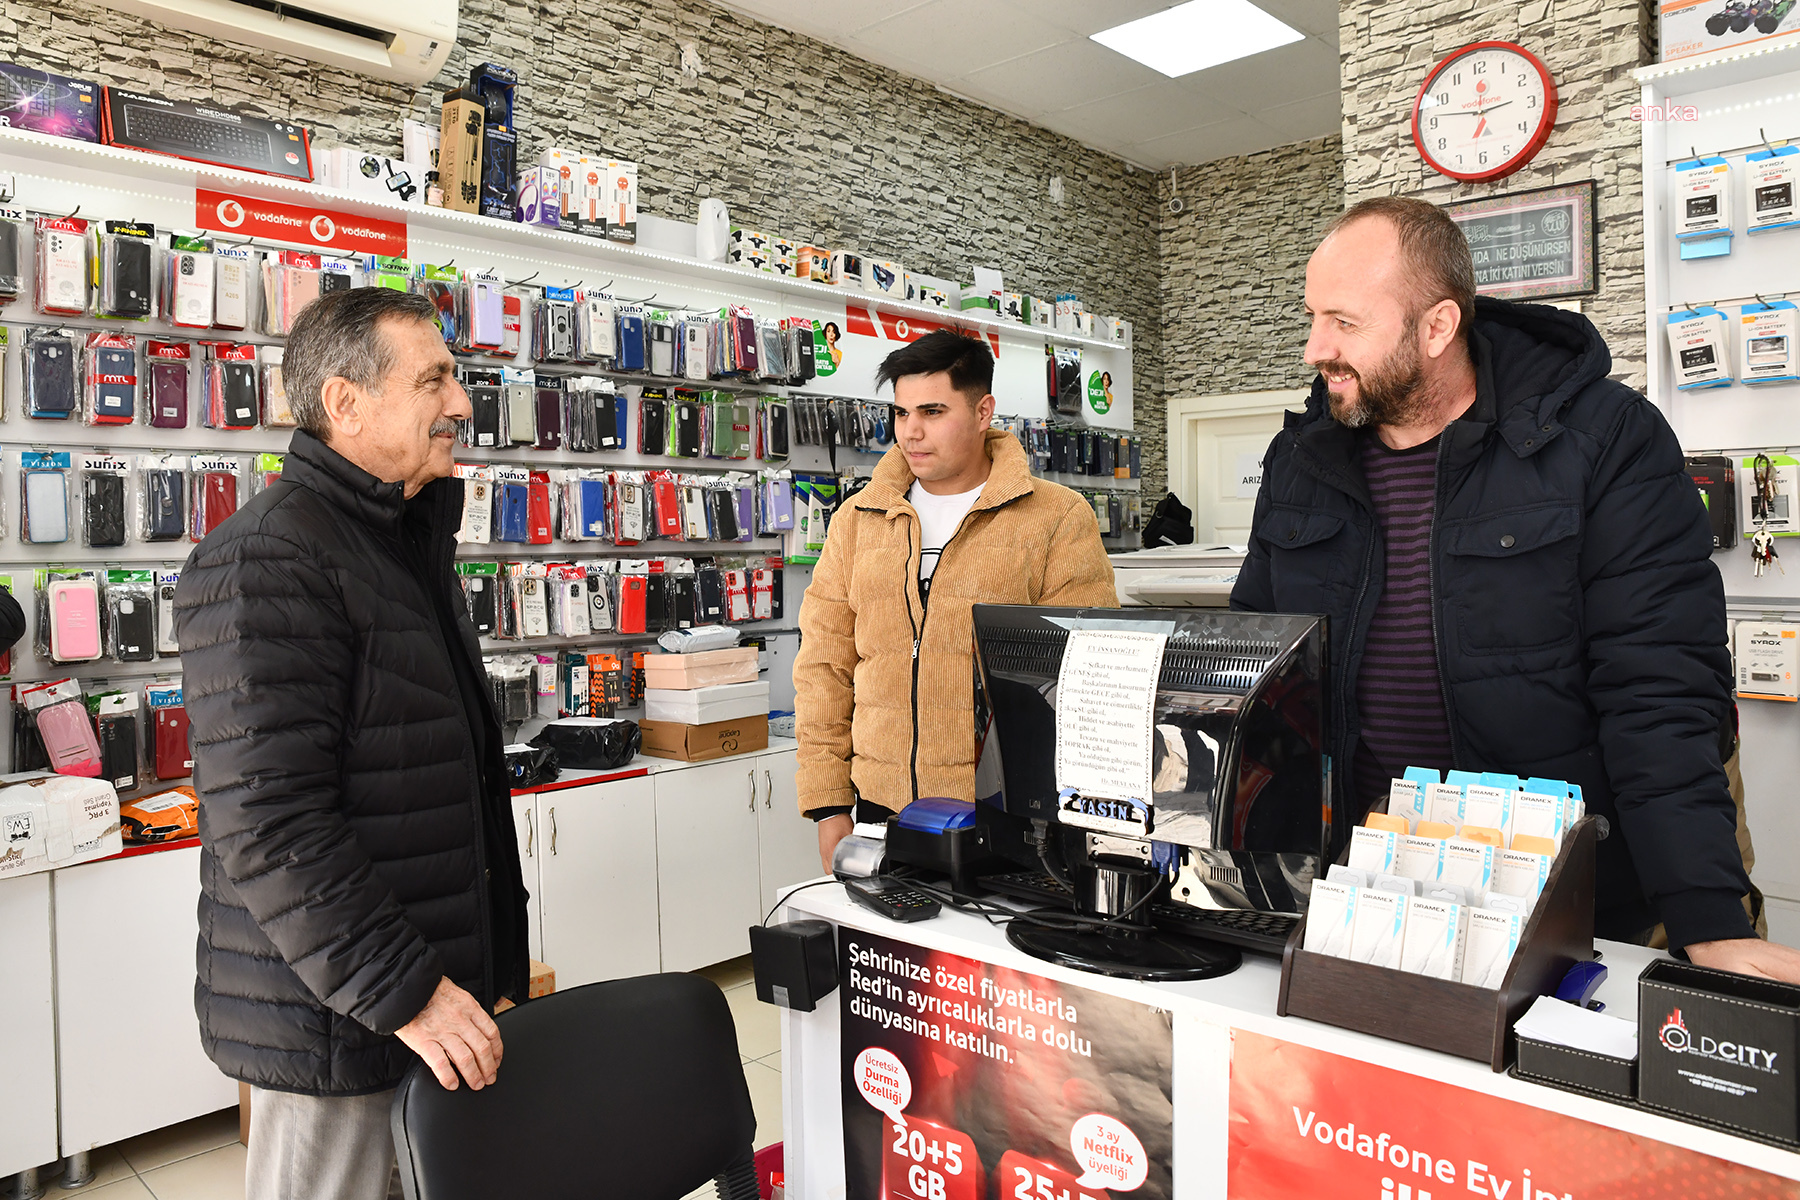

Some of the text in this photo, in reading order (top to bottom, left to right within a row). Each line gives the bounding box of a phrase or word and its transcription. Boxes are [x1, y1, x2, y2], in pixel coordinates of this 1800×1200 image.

[1665, 42, 1704, 56] SPEAKER
[1474, 61, 1486, 75] 12
[1502, 62, 1505, 74] 1
[1453, 72, 1461, 86] 11
[1518, 74, 1526, 87] 2
[1436, 92, 1449, 106] 10
[1462, 94, 1502, 109] vodafone
[1527, 95, 1536, 108] 3
[1430, 117, 1438, 130] 9
[1518, 120, 1528, 134] 4
[1438, 138, 1446, 150] 8
[1502, 144, 1510, 156] 5
[1456, 154, 1462, 164] 7
[1478, 151, 1488, 164] 6
[1759, 160, 1784, 168] SYROX
[254, 212, 302, 227] vodafone
[342, 226, 386, 240] vodafone
[1496, 248, 1508, 261] NE
[1510, 240, 1571, 261] DÜŞÜNÜRSEN
[1490, 266, 1500, 281] İKİ
[1502, 263, 1530, 280] KATINI
[1532, 258, 1564, 276] VERSİN
[1680, 321, 1704, 329] SYROX
[84, 460, 126, 470] sunix
[201, 460, 238, 470] sunix
[1785, 672, 1791, 680] 8
[1394, 782, 1422, 790] DRAMEX
[1436, 788, 1466, 796] DRAMEX
[1470, 789, 1500, 798] DRAMEX
[1520, 796, 1552, 804] DRAMEX
[1356, 831, 1384, 840] DRAMEX
[1406, 840, 1436, 848] DRAMEX
[1450, 844, 1480, 854] DRAMEX
[1504, 854, 1536, 863] DRAMEX
[1362, 894, 1394, 904] DRAMEX
[1414, 902, 1446, 913] DRAMEX
[1473, 913, 1506, 924] DRAMEX
[848, 942, 1078, 1024] Şehrinize özel fiyatlarla
[850, 969, 1092, 1057] Red’in ayrıcalıklarla dolu
[850, 996, 1014, 1064] dünyasına katılın.
[1666, 1028, 1778, 1069] OLDCITY
[865, 1052, 898, 1074] Ücretsiz
[865, 1066, 899, 1088] Durma
[862, 1078, 902, 1106] Özelliği
[1097, 1126, 1120, 1144] 3 ay
[892, 1124, 962, 1176] 20+5
[1084, 1137, 1134, 1166] Netflix
[1292, 1106, 1456, 1184] Vodafone
[1467, 1160, 1512, 1200] Ev
[1088, 1157, 1128, 1182] üyeliği
[908, 1164, 946, 1200] GB
